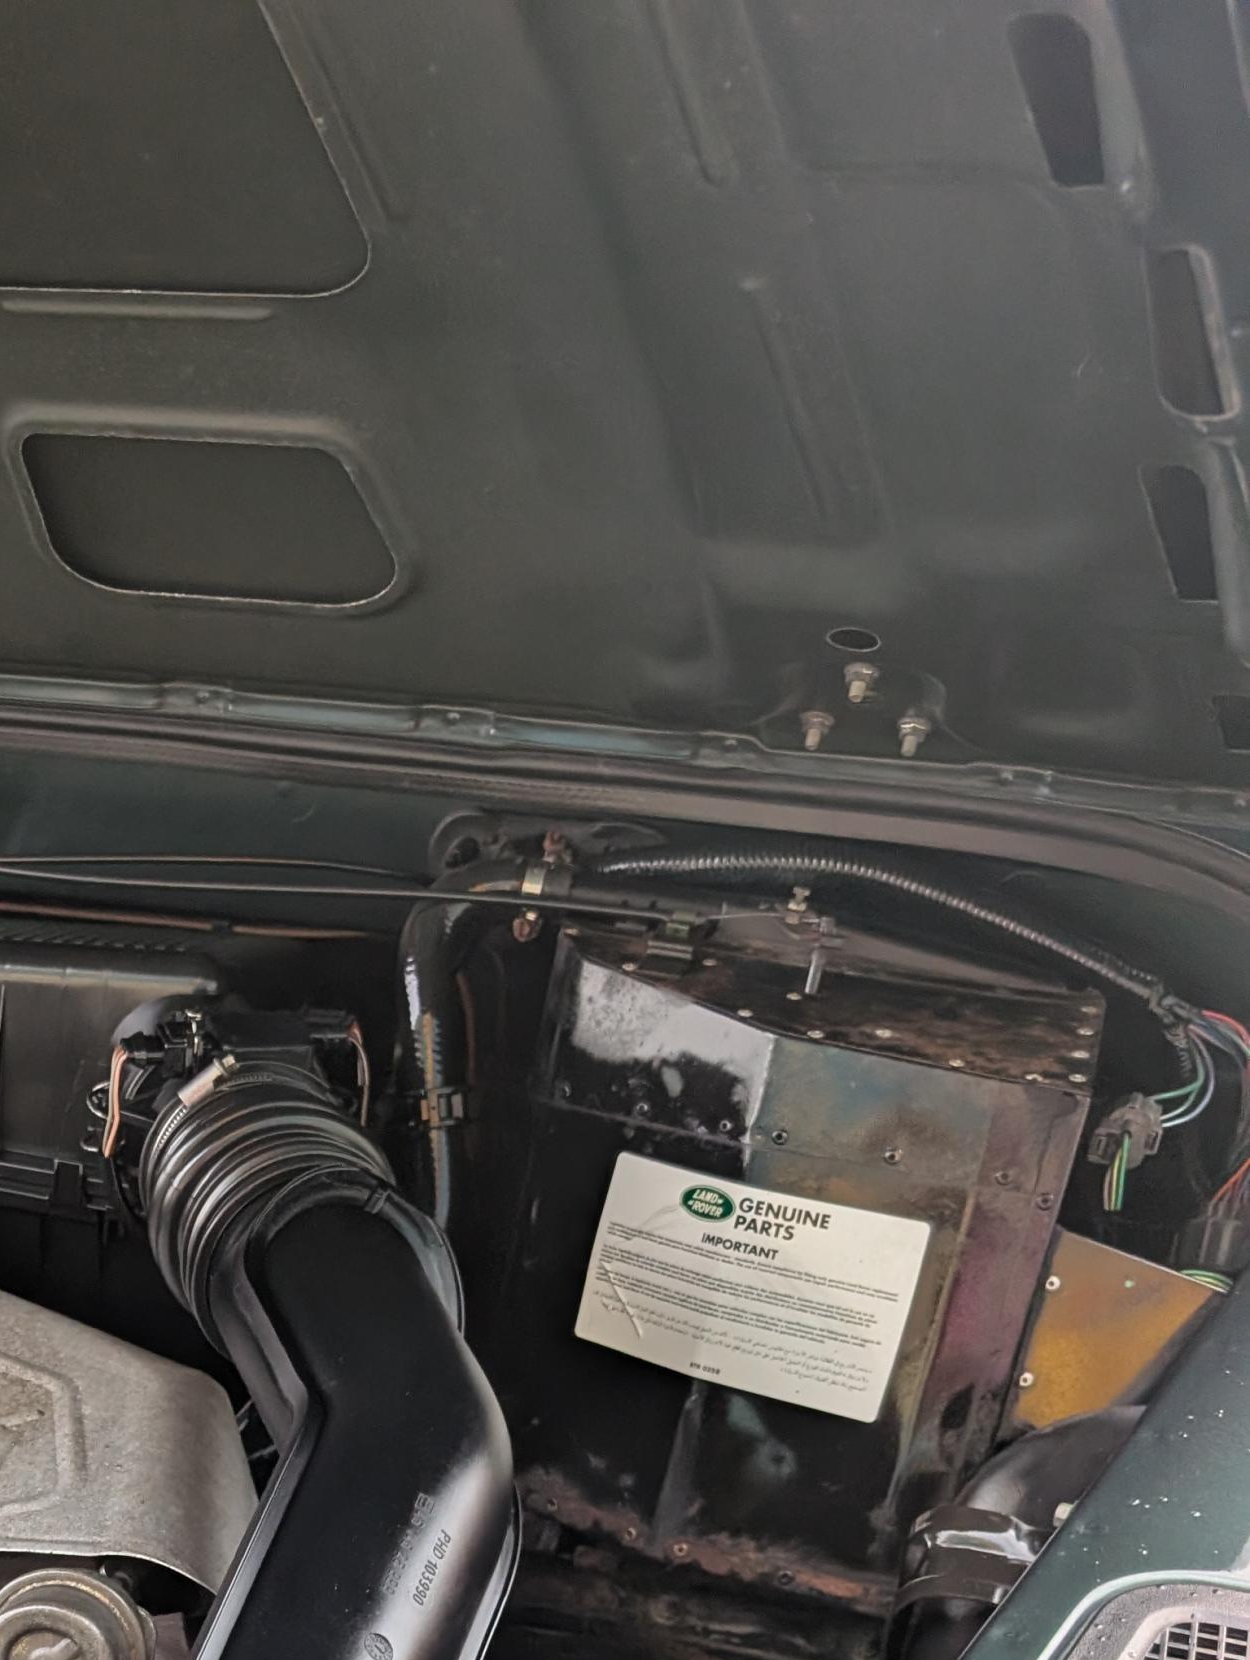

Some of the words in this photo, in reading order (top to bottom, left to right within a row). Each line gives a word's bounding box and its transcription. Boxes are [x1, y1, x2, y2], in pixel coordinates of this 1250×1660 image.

[691, 1200, 724, 1219] ROVER
[692, 1188, 720, 1204] LAND
[734, 1214, 796, 1242] PARTS
[739, 1197, 832, 1230] GENUINE
[701, 1232, 779, 1261] IMPORTANT
[432, 1529, 452, 1560] PHD
[412, 1559, 439, 1606] 103990
